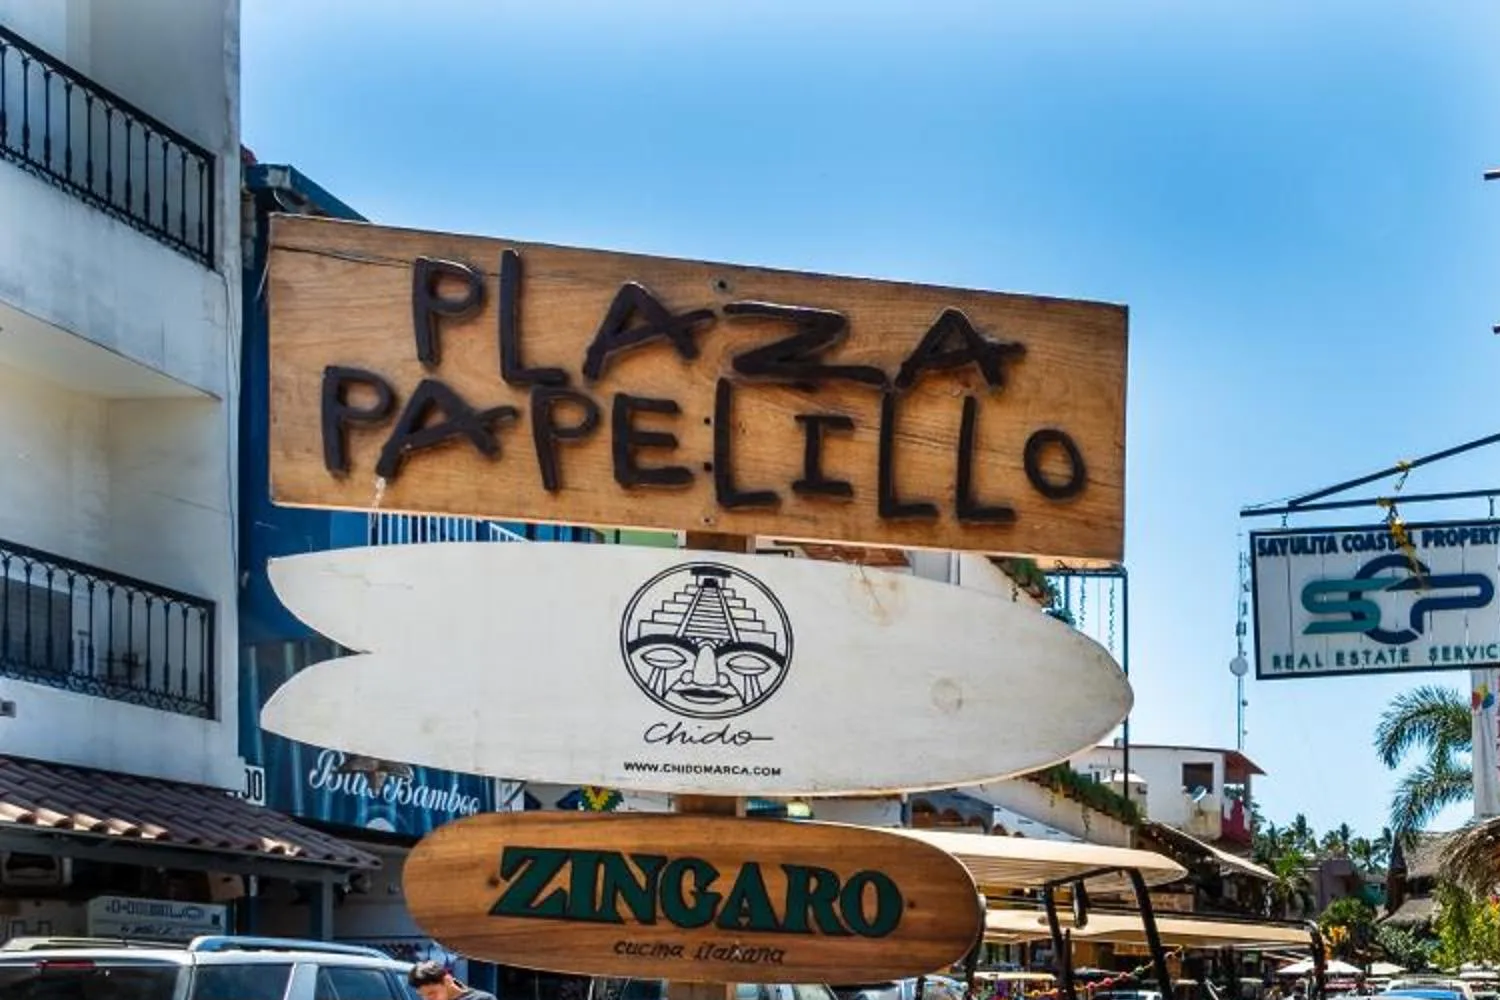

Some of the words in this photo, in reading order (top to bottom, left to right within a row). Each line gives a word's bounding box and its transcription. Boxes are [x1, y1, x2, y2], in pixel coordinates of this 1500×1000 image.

[412, 249, 1026, 389] PLAZA
[321, 364, 1088, 524] PAPELILLO
[1258, 534, 1338, 557] SAYULITA
[1341, 529, 1417, 554] COASTL
[1272, 653, 1323, 671] REAL
[1335, 647, 1410, 666] ESTATE
[643, 721, 774, 747] Chido
[623, 761, 782, 777] WWW.CHIDOMARCA.COM
[488, 845, 905, 940] ZINGARO
